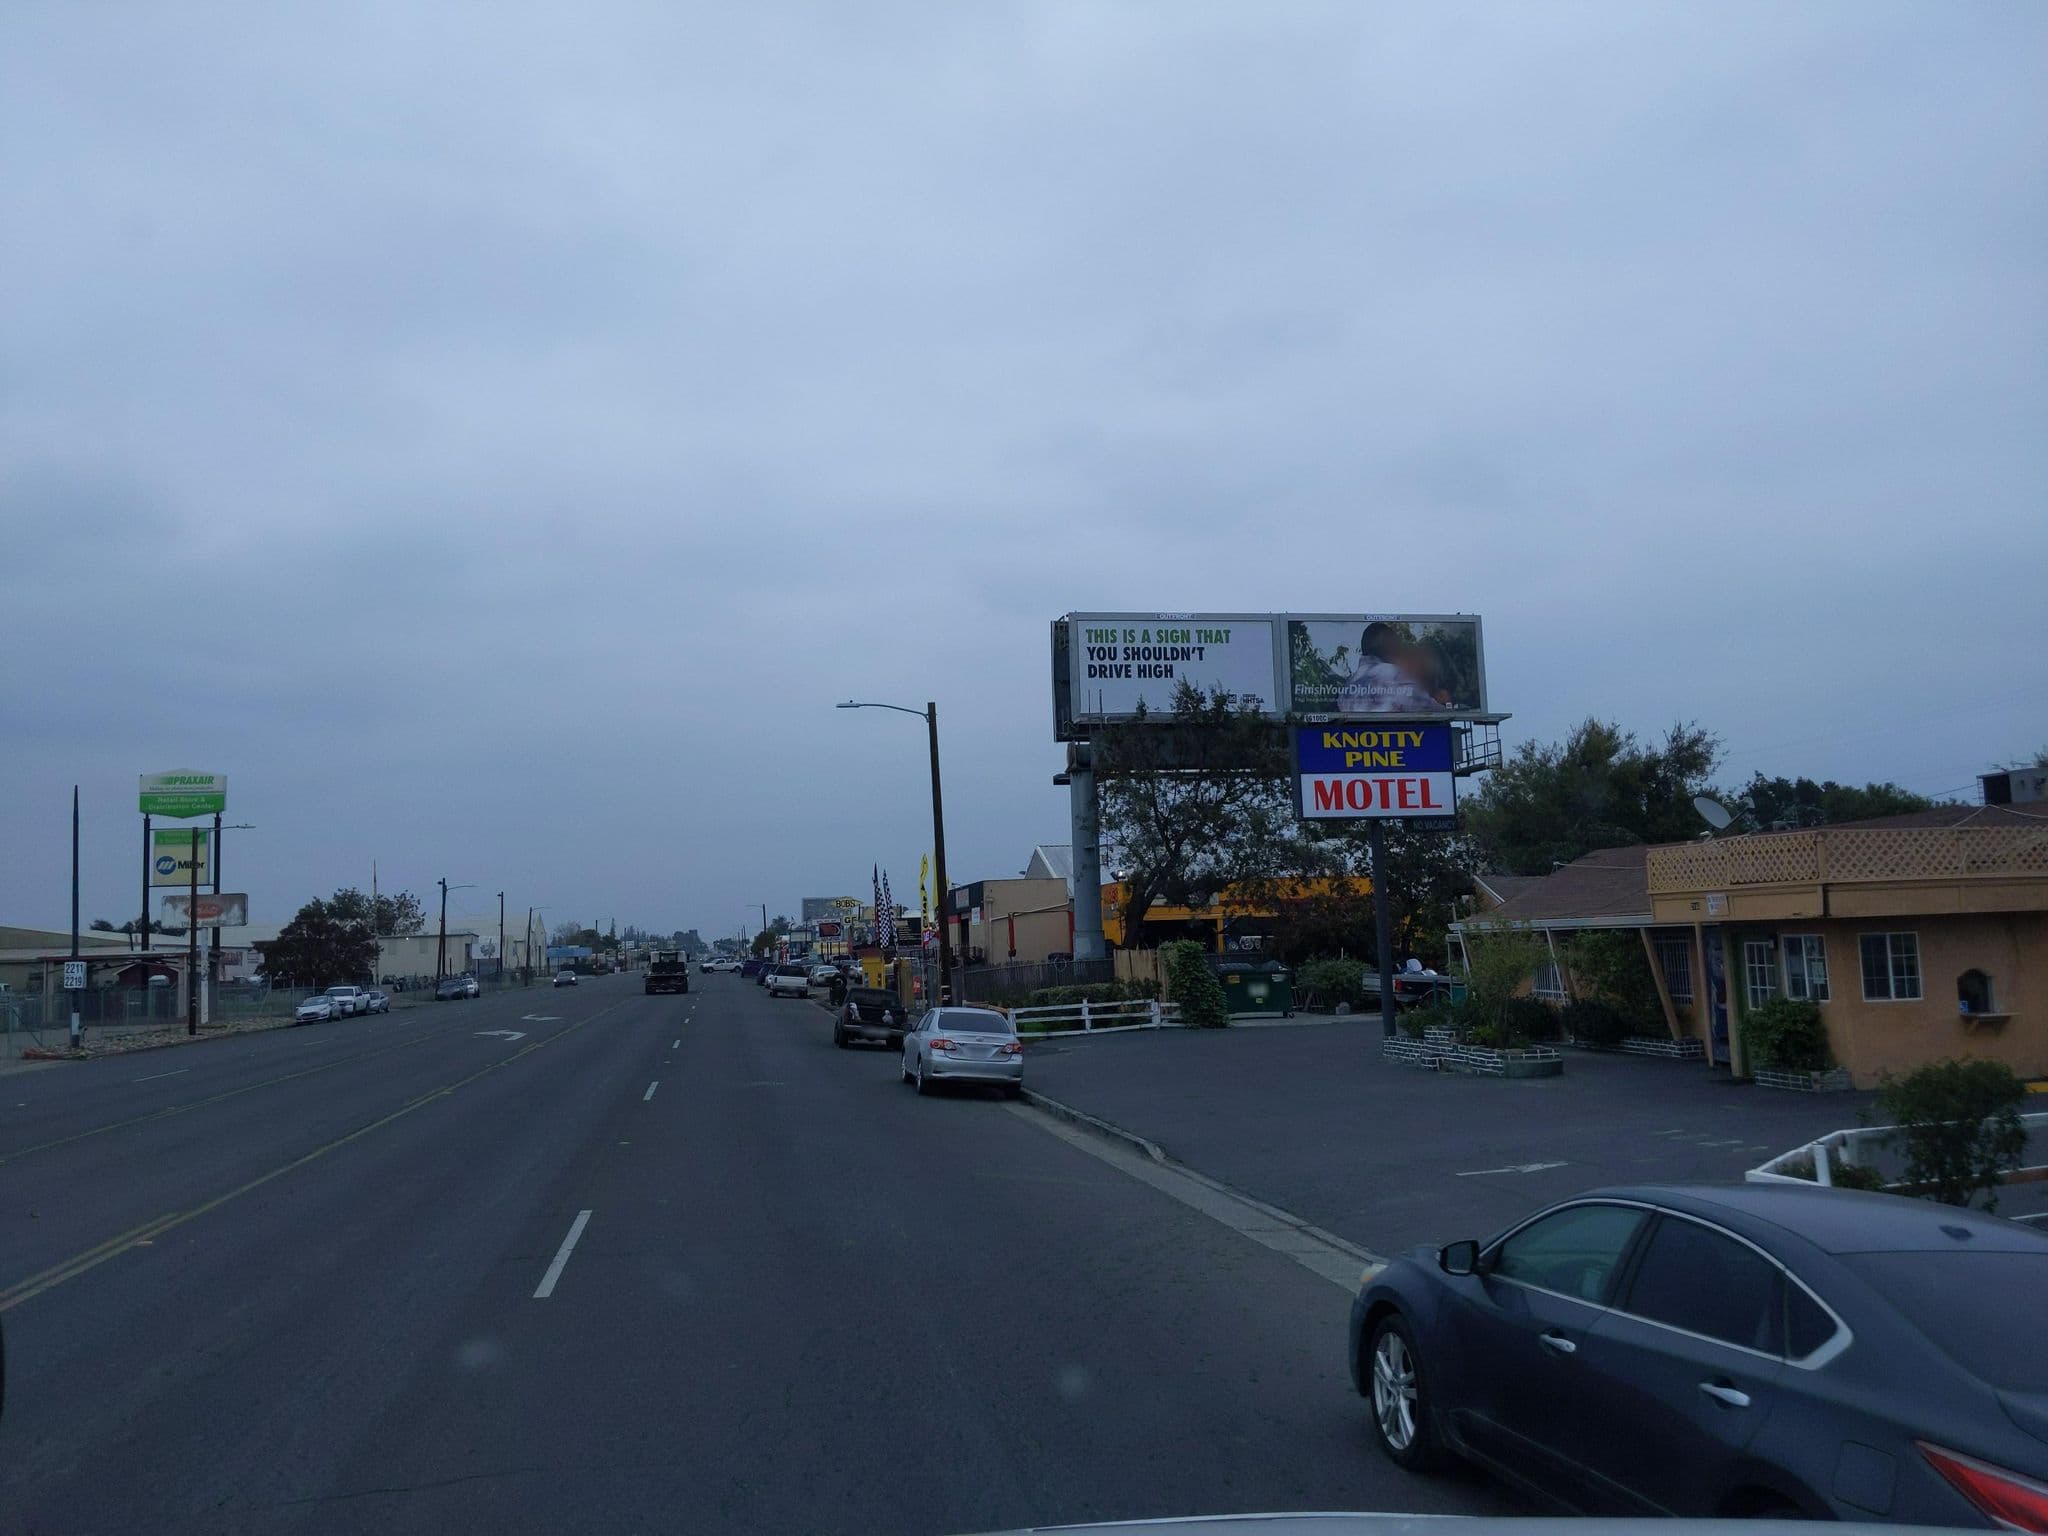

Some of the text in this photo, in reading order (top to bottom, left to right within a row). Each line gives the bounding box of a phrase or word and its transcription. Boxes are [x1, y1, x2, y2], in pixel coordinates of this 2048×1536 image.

[1086, 629, 1231, 643] THIS IS A SIGN THAT
[1086, 646, 1205, 661] YOU SHOULDN'T
[1087, 663, 1174, 679] DRIVE HIGH
[1294, 683, 1414, 697] FinishYourDiploma.org
[1322, 730, 1425, 748] KNOTTY
[1345, 751, 1406, 768] PINE
[173, 776, 215, 785] PRAXAIR
[1313, 777, 1443, 811] MOTEL
[66, 963, 83, 974] 2211
[65, 976, 82, 987] 2219
